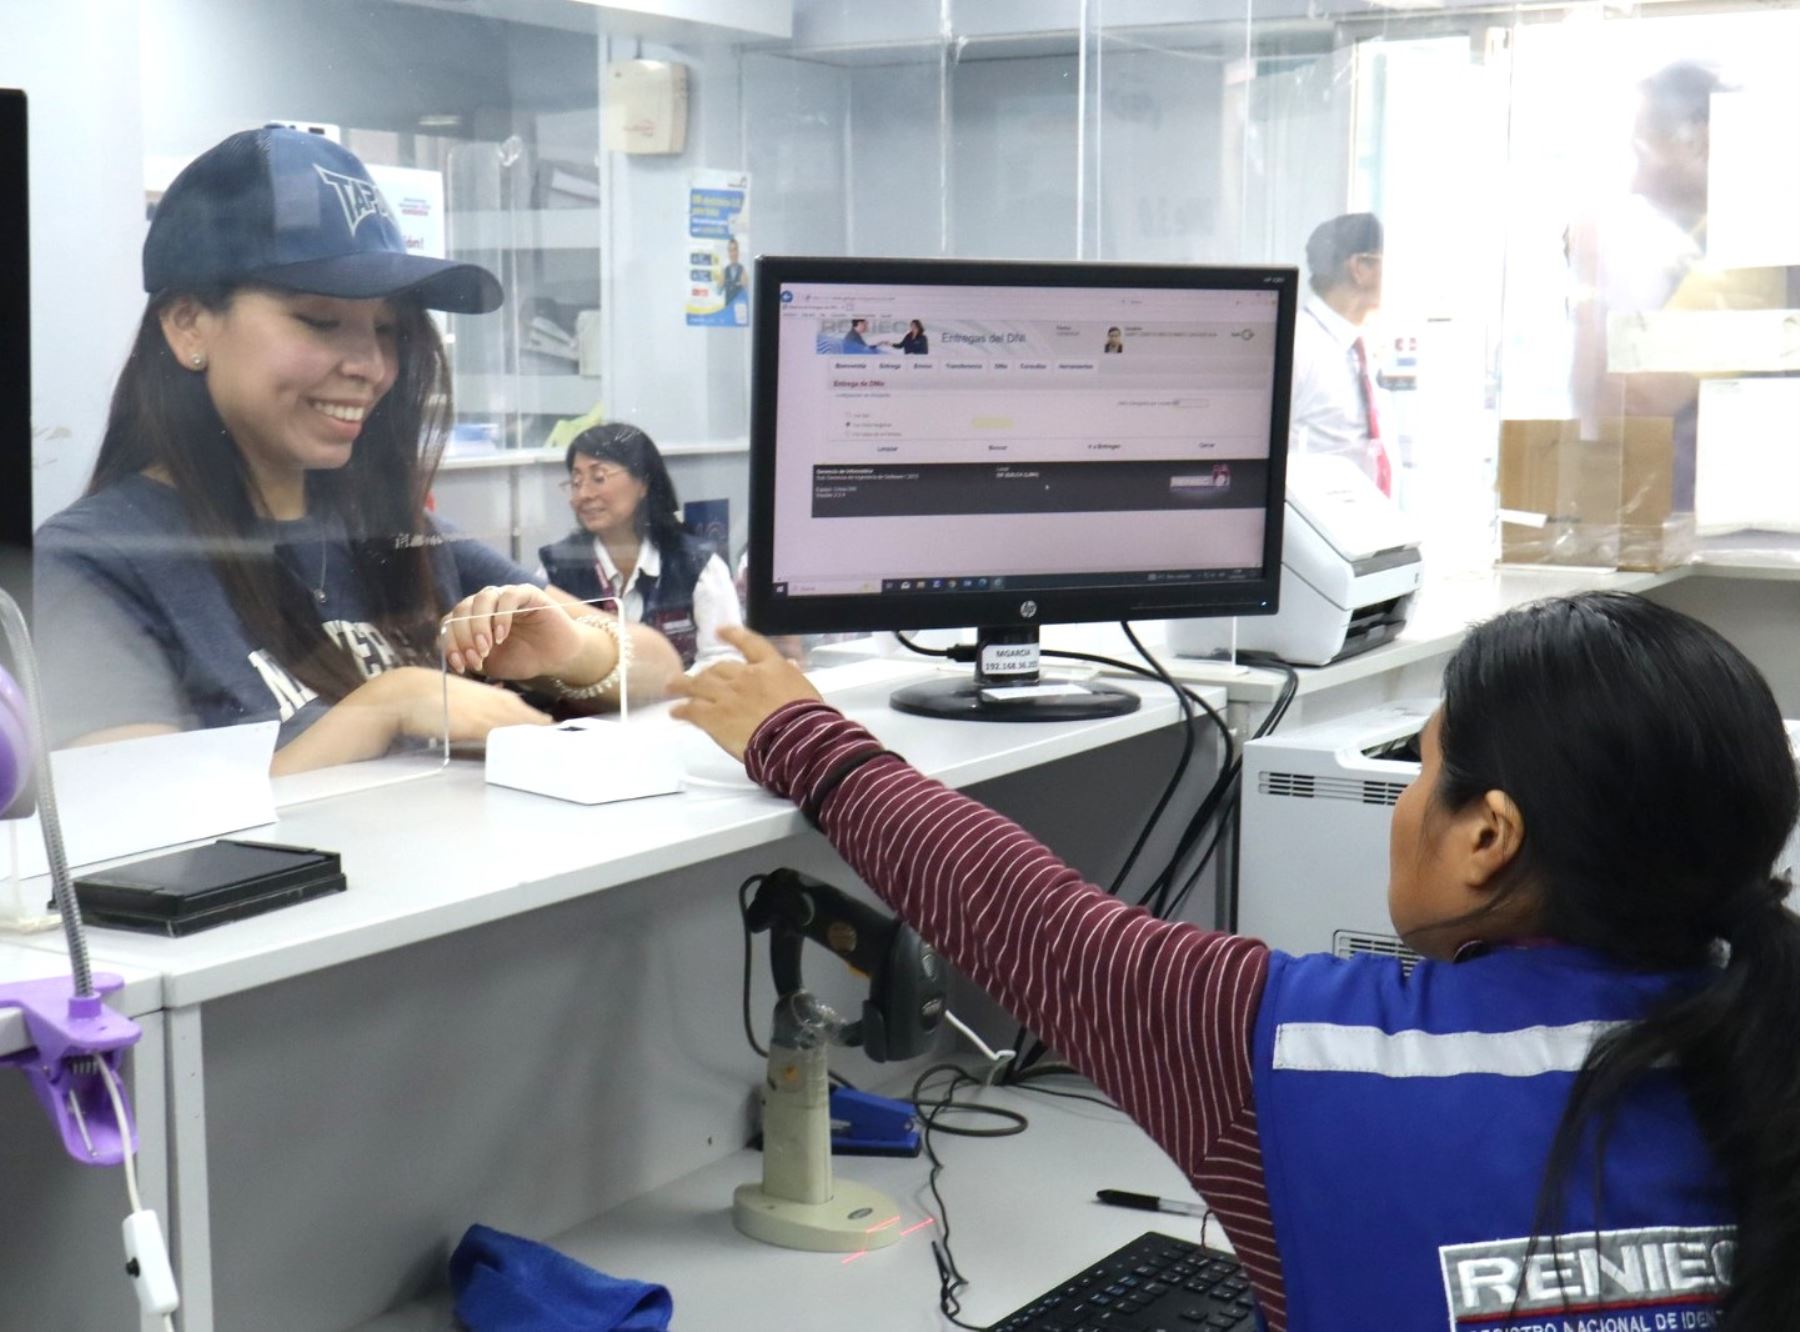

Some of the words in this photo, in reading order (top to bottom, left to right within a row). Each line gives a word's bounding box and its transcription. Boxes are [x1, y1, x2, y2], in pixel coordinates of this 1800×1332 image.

[941, 333, 986, 345] Entregas
[988, 333, 1003, 343] del
[1655, 1312, 1678, 1330] DE
